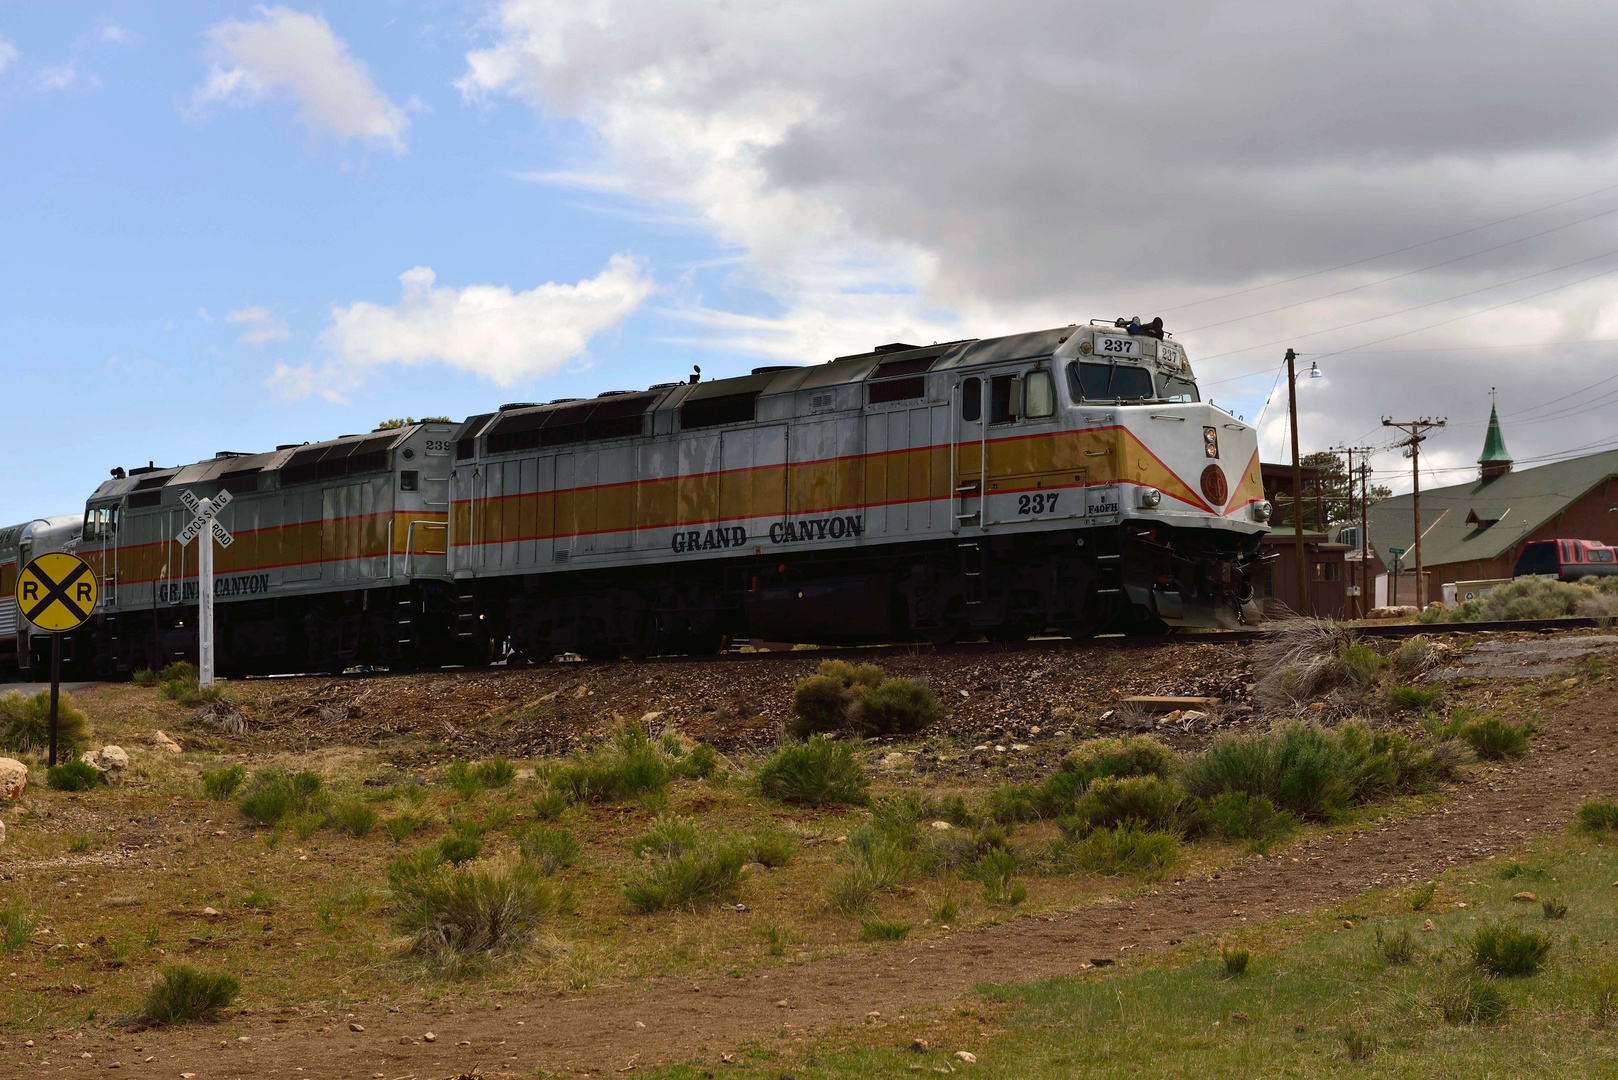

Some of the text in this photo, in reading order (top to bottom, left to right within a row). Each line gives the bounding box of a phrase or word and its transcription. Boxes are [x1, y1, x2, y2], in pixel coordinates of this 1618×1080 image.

[1104, 338, 1133, 353] 237
[1162, 347, 1177, 363] 237
[426, 440, 450, 451] 239
[1018, 493, 1060, 515] 237
[1088, 503, 1118, 514] F40FH
[182, 494, 227, 541] CROSSING
[182, 492, 231, 545] RAIL ROAD
[671, 515, 862, 553] GRAND CANYON
[23, 581, 92, 602] R R
[159, 574, 269, 602] GRAN CANYON
